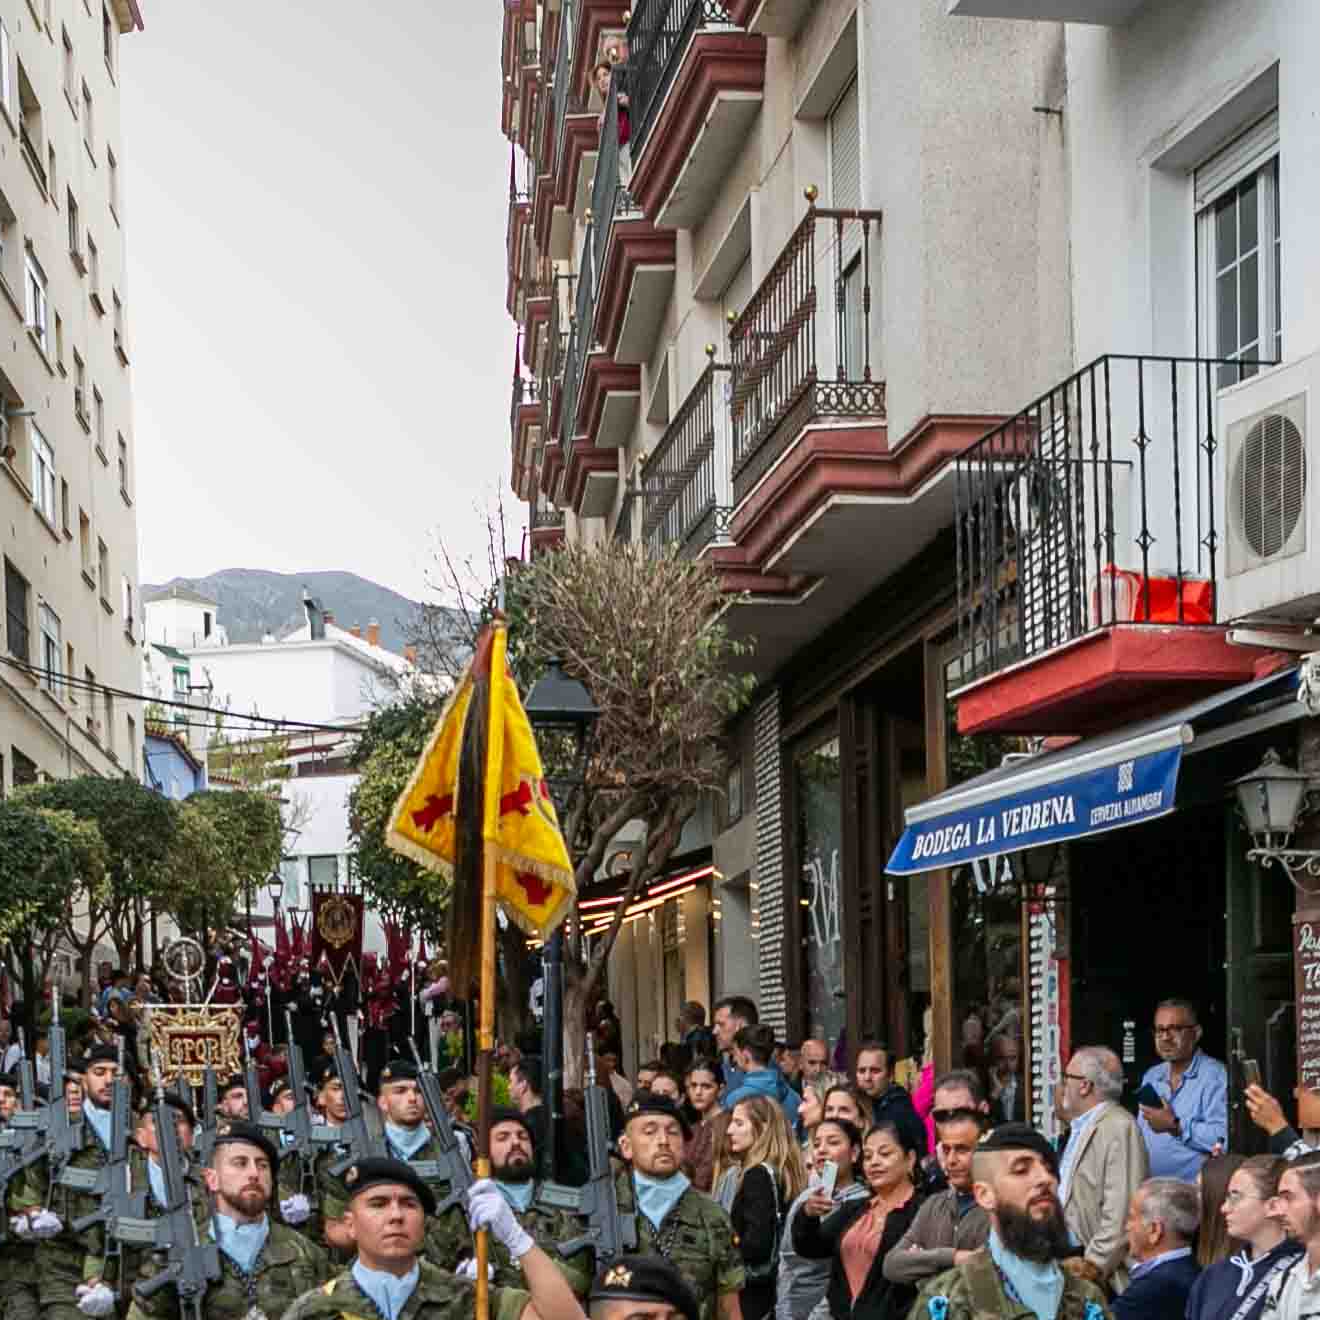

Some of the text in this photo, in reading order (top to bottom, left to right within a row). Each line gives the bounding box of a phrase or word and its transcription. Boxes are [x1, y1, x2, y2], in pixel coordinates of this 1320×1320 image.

[911, 796, 1075, 860] BODEGA LA VERBENA
[171, 1038, 218, 1062] SPQR
